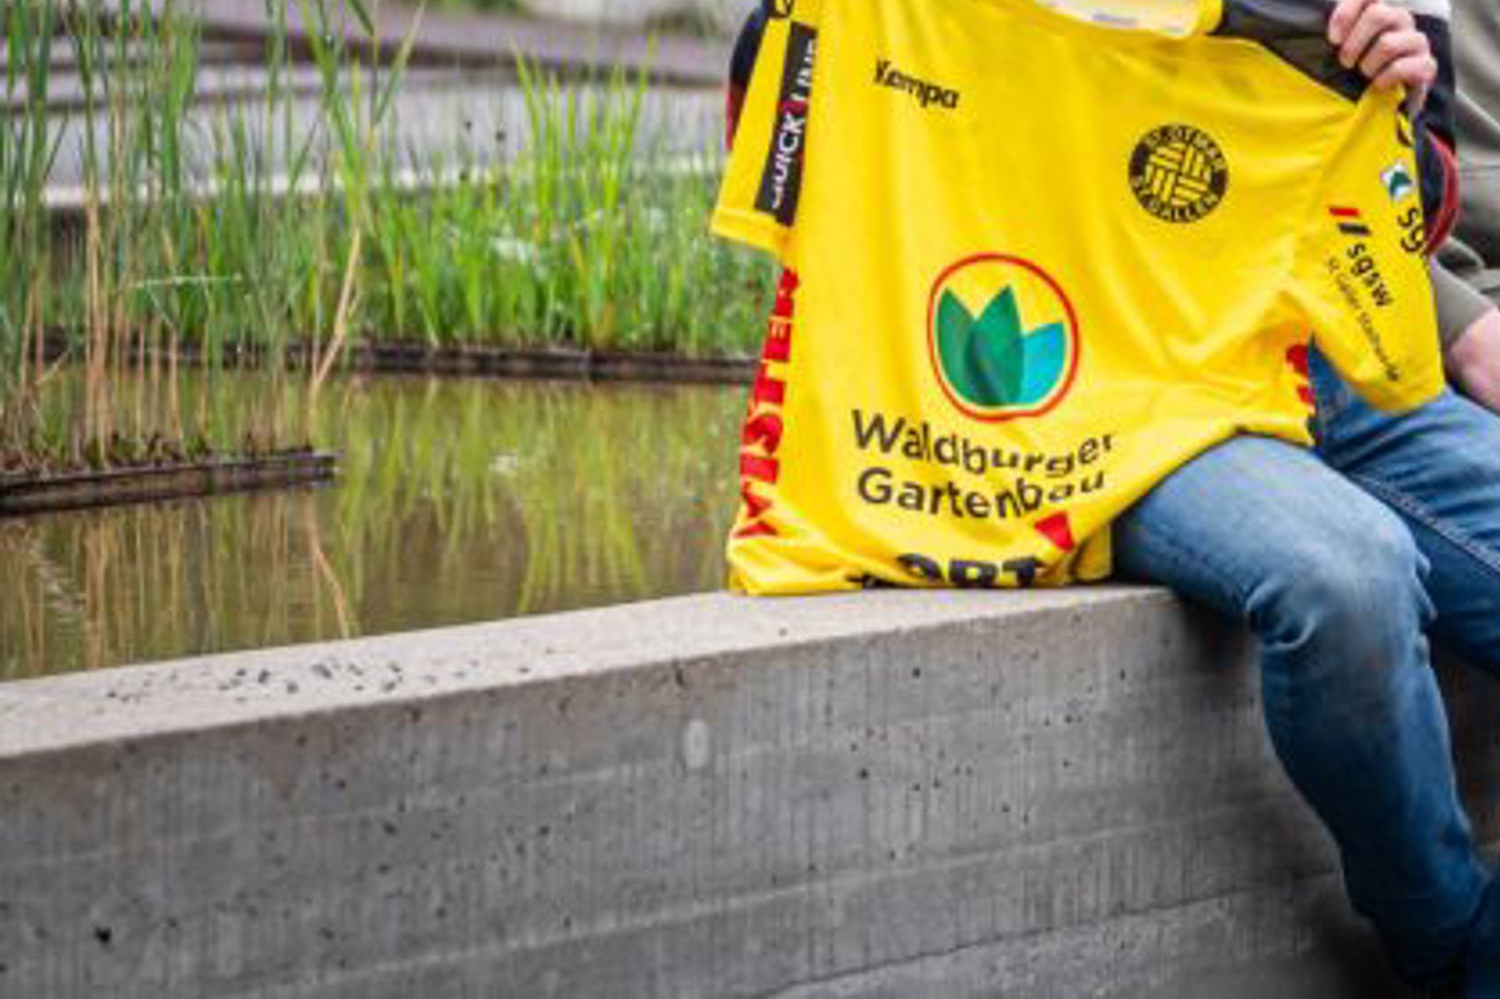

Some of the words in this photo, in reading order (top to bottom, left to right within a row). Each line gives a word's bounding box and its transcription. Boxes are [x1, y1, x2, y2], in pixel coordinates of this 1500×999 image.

[874, 59, 960, 110] Kempa
[1346, 243, 1394, 307] sgsw
[852, 409, 1114, 478] Waldburger
[857, 467, 1104, 519] Gartenbau
